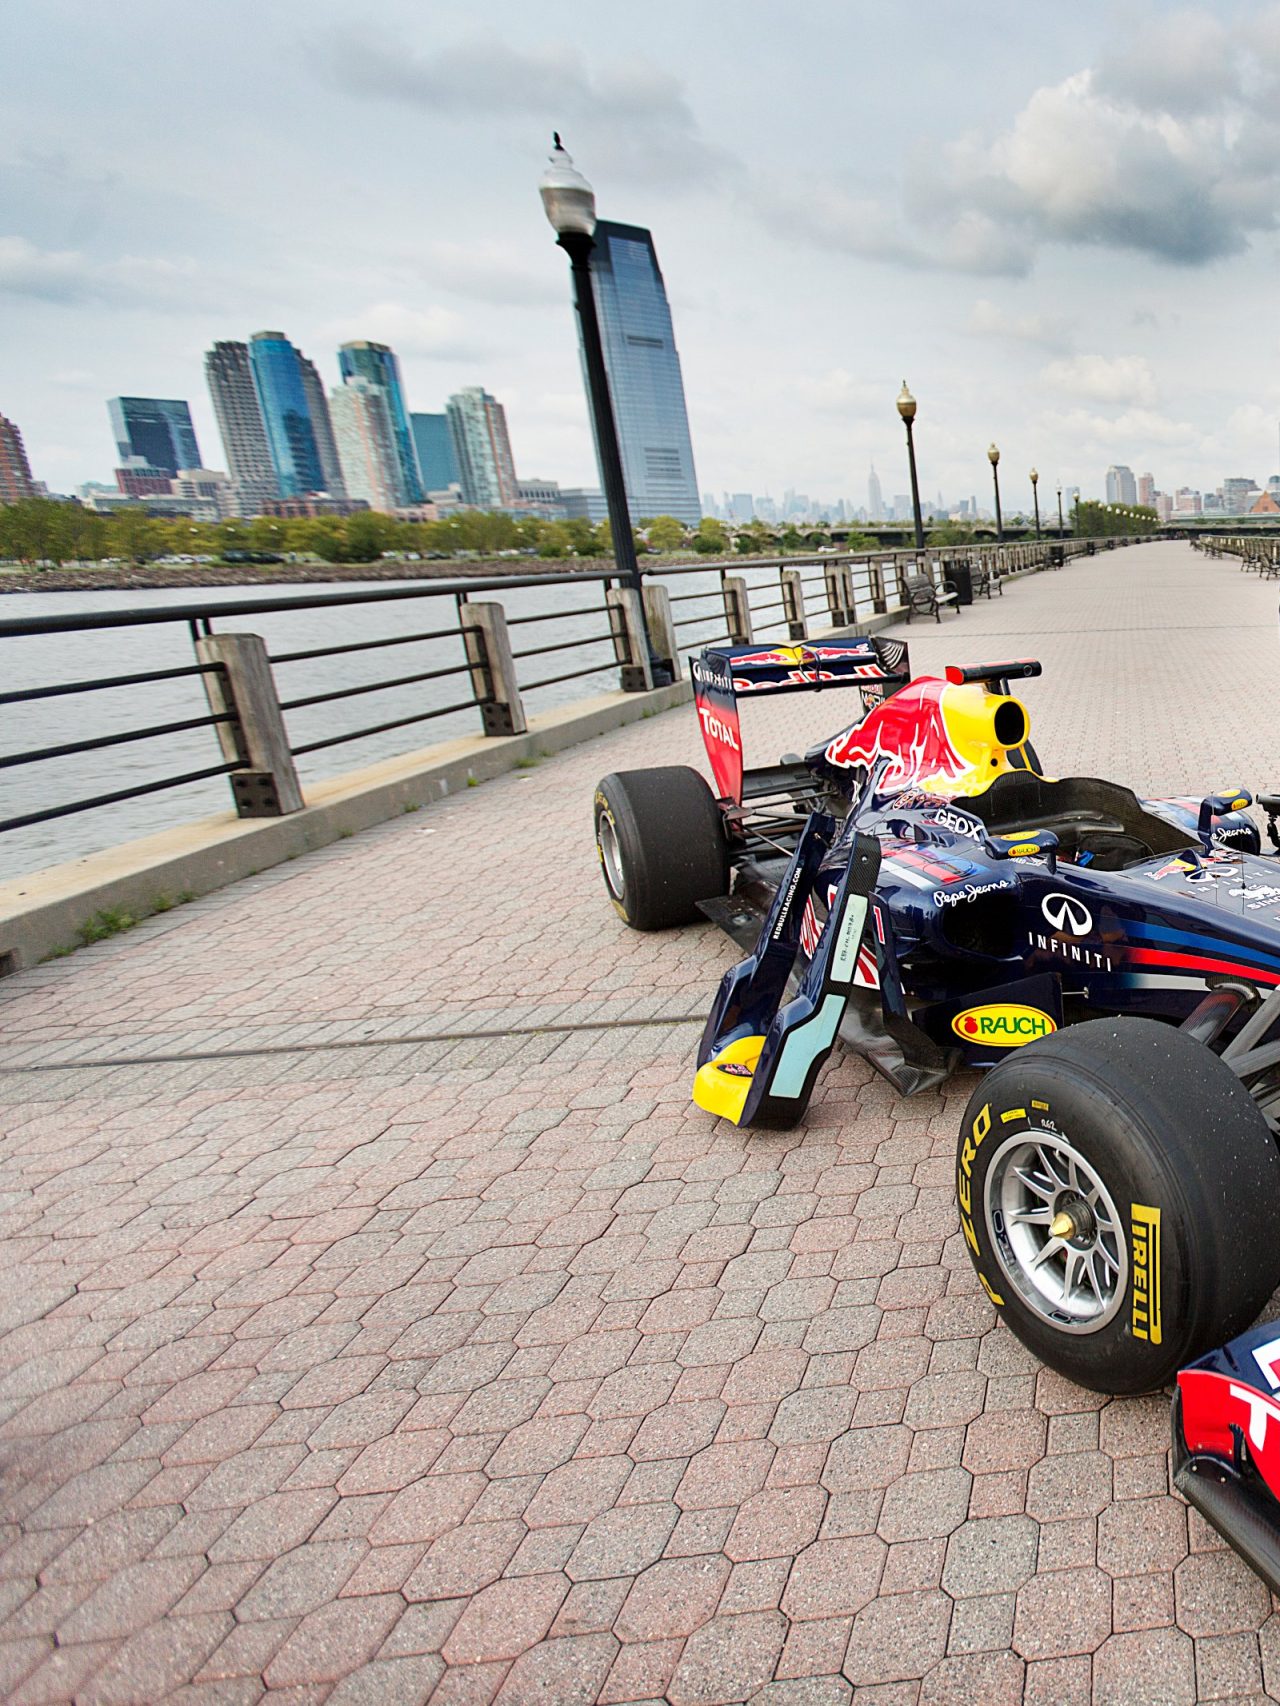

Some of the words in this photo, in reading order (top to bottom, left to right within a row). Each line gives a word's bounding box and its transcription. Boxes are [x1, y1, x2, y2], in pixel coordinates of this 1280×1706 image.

[699, 707, 740, 751] TOTAL
[933, 808, 985, 843] GEOX
[1216, 827, 1253, 843] Jeans
[772, 867, 803, 940] REDBULLRACING.COM
[933, 890, 968, 908] Pepe
[964, 879, 1010, 903] Jeans
[1028, 931, 1112, 972] INFINITI
[980, 1016, 1046, 1035] RAUCH
[958, 1102, 992, 1257] ZERO
[1131, 1202, 1163, 1345] PIRELLI
